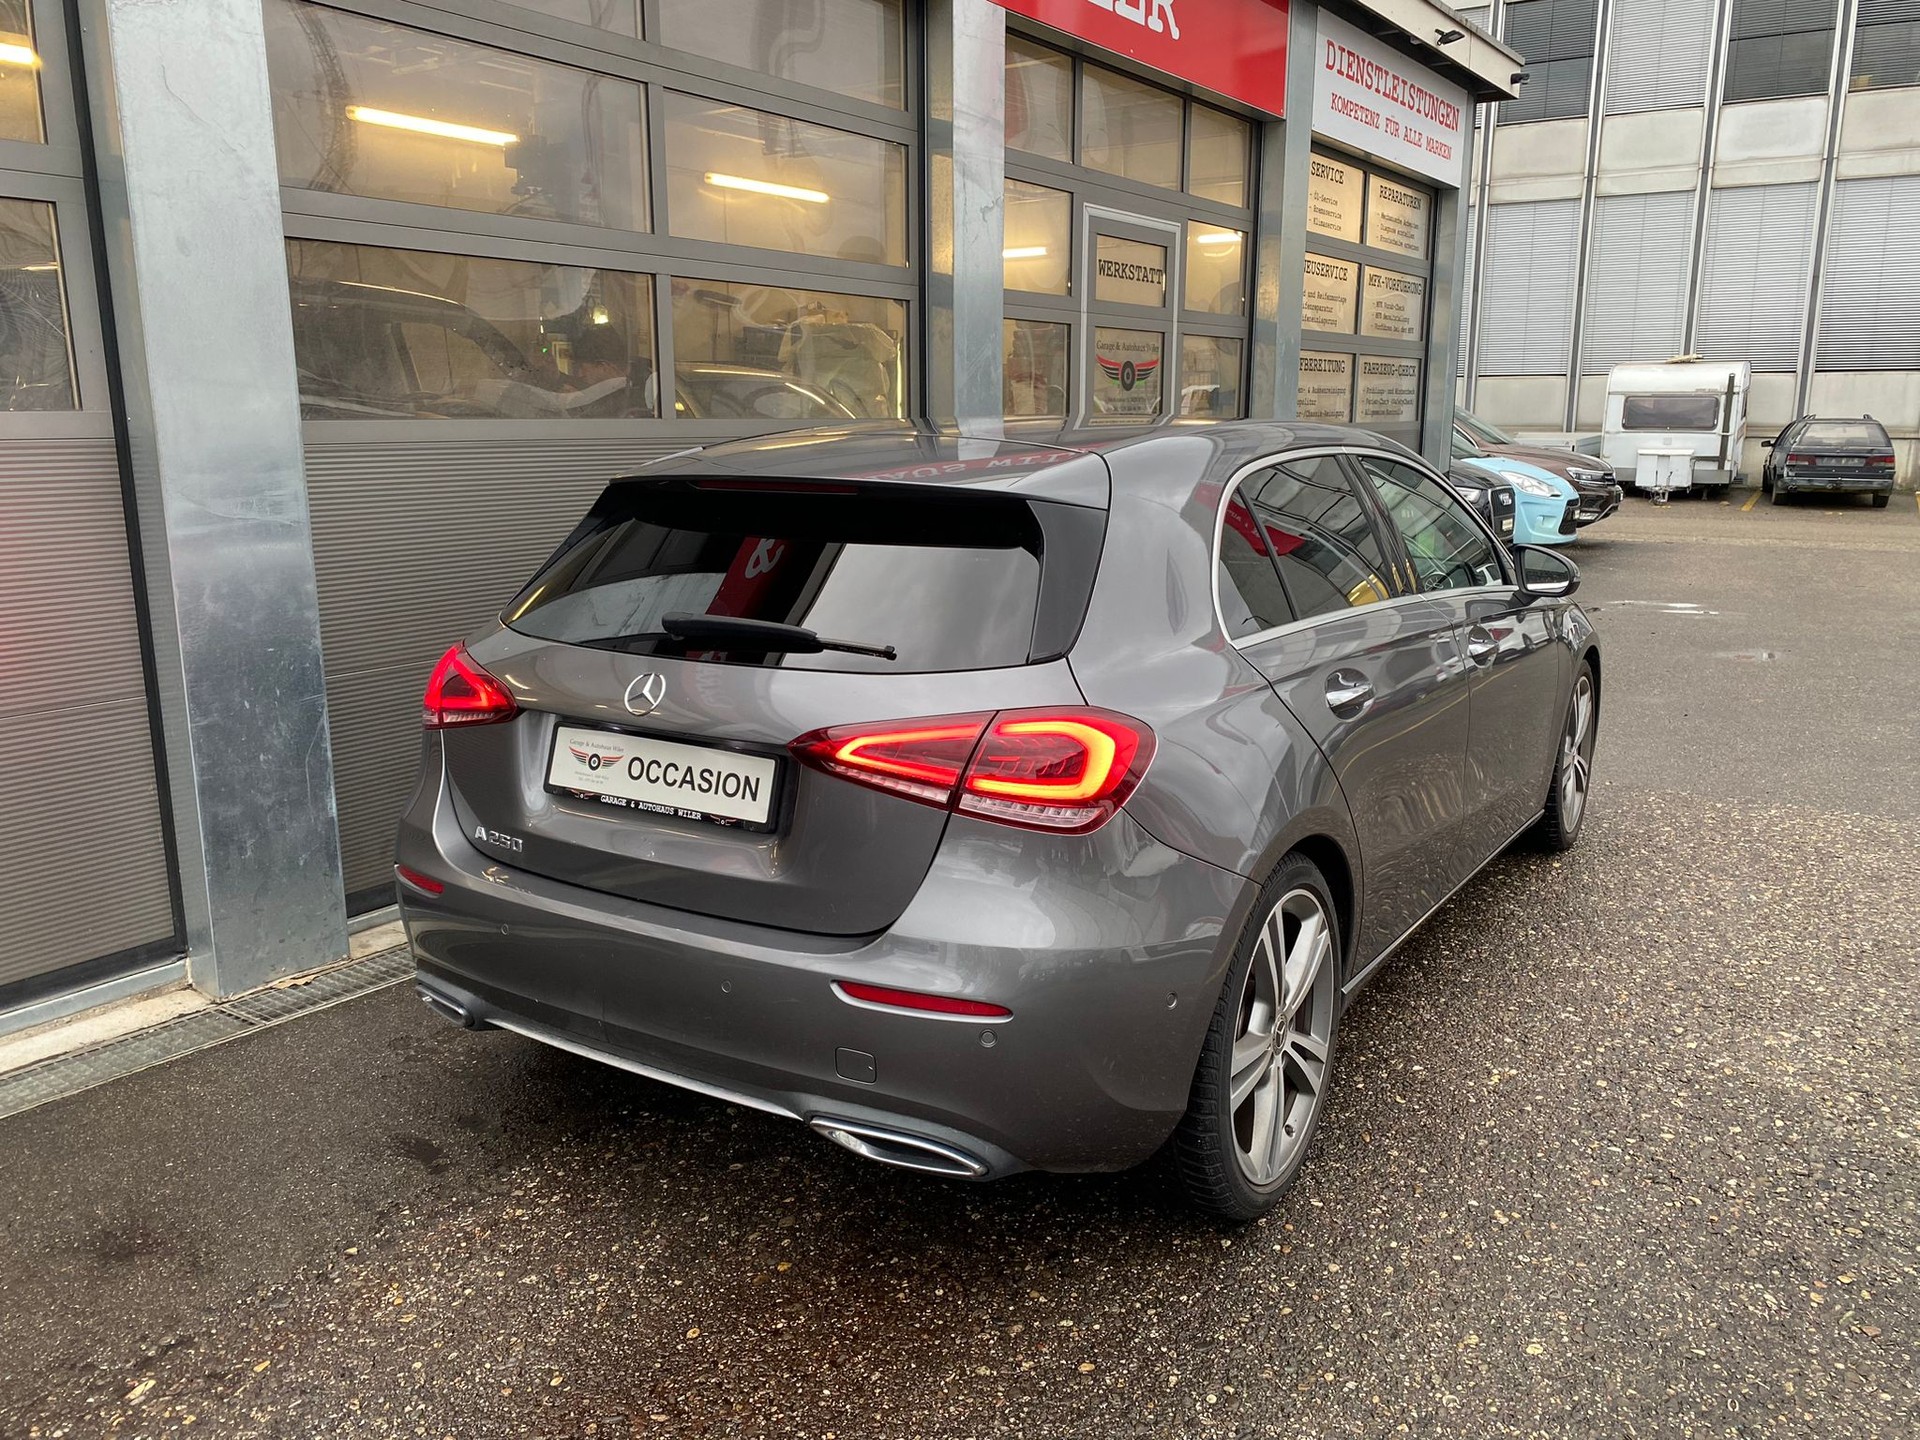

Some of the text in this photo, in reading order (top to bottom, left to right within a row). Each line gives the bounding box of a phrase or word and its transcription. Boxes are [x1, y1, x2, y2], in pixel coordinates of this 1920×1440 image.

[1325, 39, 1460, 132] DIENSTLEISTUNGEN
[1331, 92, 1452, 161] KOMPETENZ FÜR ALLE MARKEN
[1310, 161, 1345, 184] SERVICE
[1098, 259, 1163, 285] WERKSTATT
[627, 756, 760, 802] OCCASION
[600, 795, 627, 806] GARAGE
[638, 802, 674, 816] AUTOHAUS
[678, 808, 702, 820] WILER
[474, 826, 523, 853] A 250
